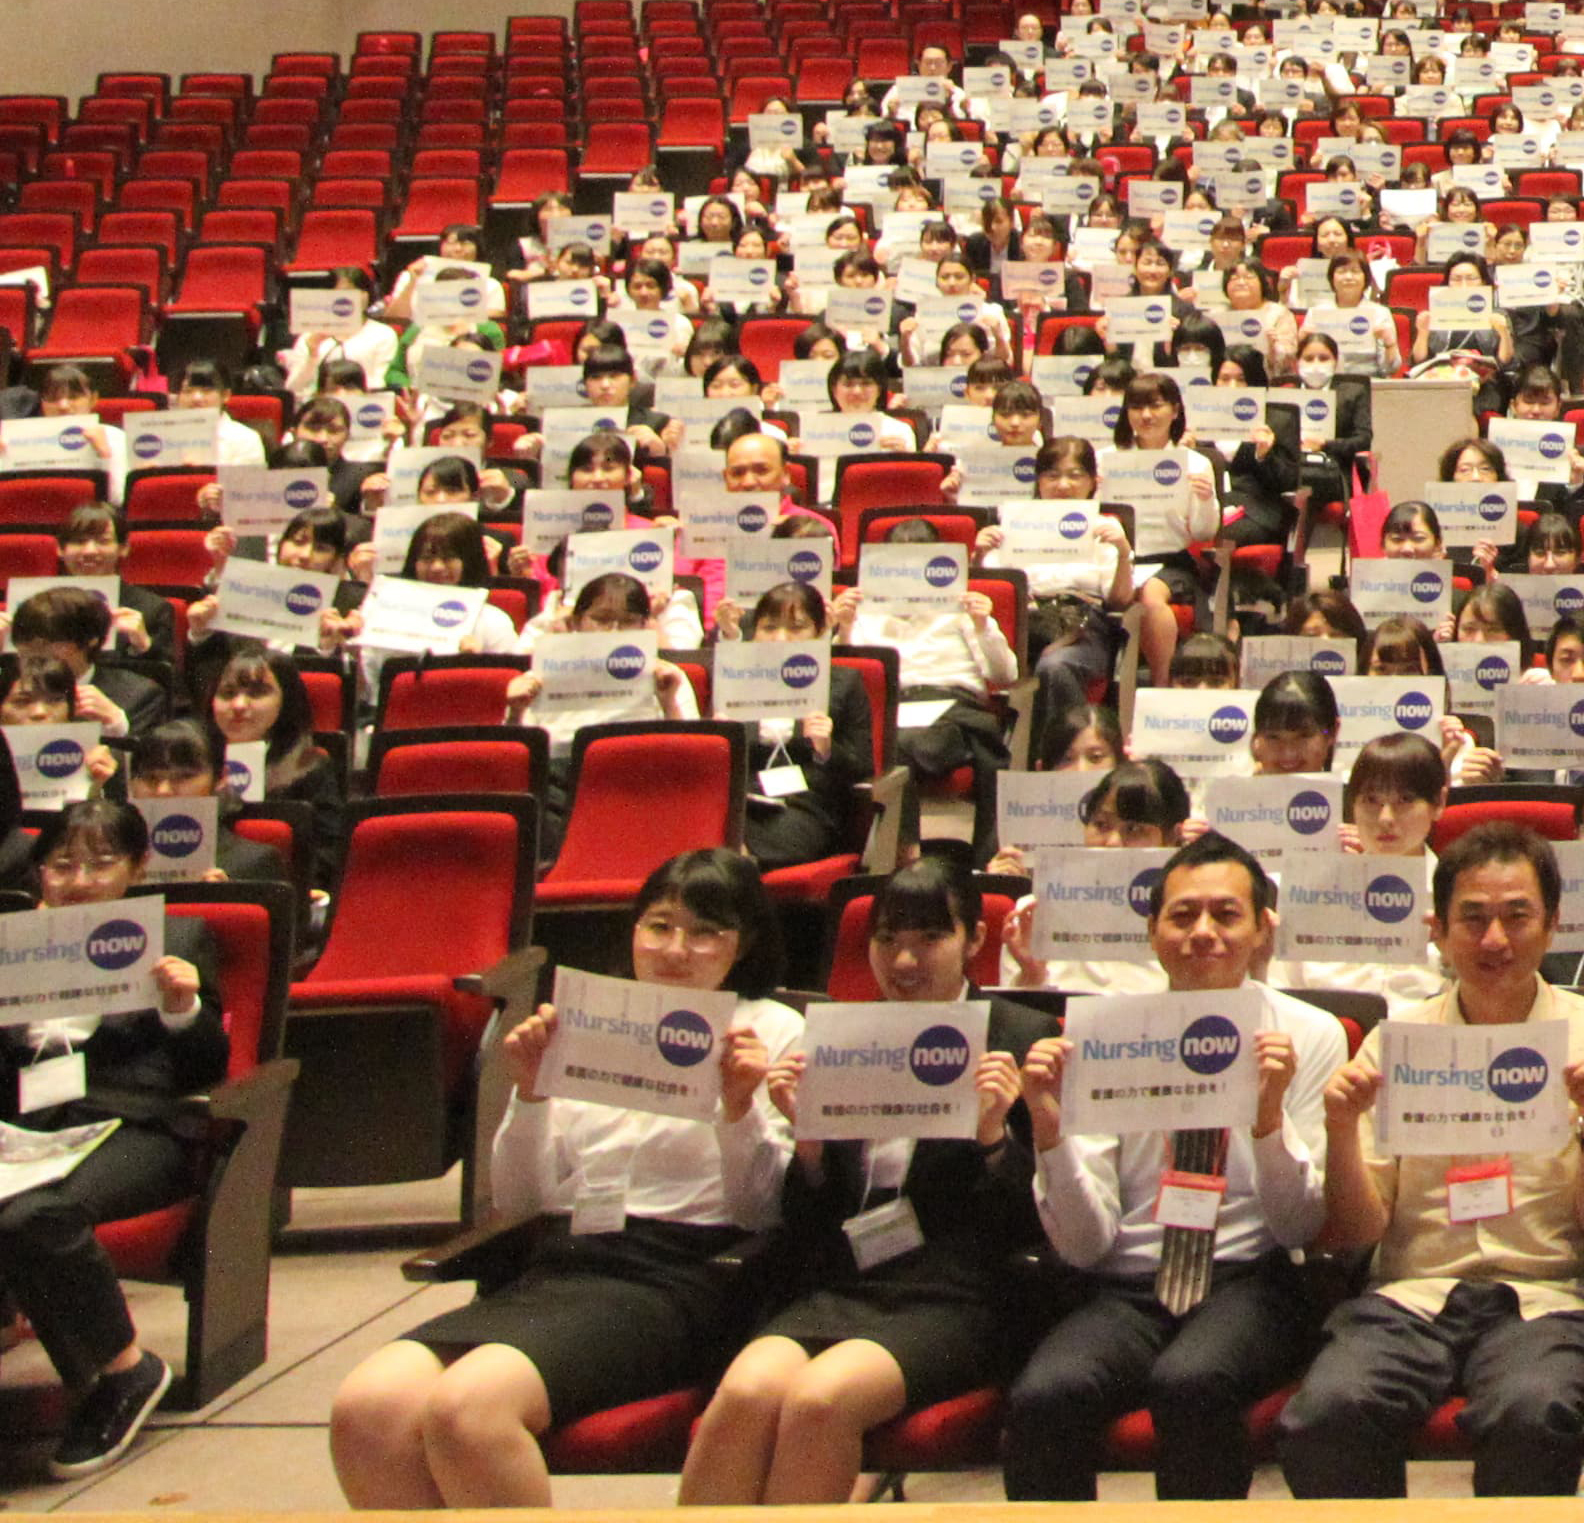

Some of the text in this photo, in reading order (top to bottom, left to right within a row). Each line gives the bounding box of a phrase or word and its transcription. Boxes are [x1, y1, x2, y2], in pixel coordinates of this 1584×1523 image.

[1234, 403, 1257, 416] now
[1540, 440, 1564, 452] now
[285, 488, 316, 501] now
[1434, 501, 1506, 515] Nursing now
[534, 511, 613, 526] Nursing now
[738, 513, 767, 525] now
[1060, 520, 1086, 533] now
[630, 551, 662, 565] now
[733, 559, 822, 575] Nursing now
[869, 565, 957, 579] Nursing now
[227, 580, 323, 608] Nursing now
[1360, 580, 1442, 595] Nursing now
[1556, 597, 1584, 609] now
[434, 606, 468, 621] now
[543, 654, 645, 675] Nursing now
[1252, 656, 1345, 675] Nursing now
[722, 665, 819, 681] Nursing now
[1477, 665, 1509, 681] now
[1395, 704, 1431, 718] now
[1144, 716, 1246, 735] Nursing now
[1505, 710, 1567, 729] Nursing
[38, 749, 83, 766] now
[1007, 801, 1074, 819] Nursing
[1216, 806, 1328, 823] Nursing now
[154, 829, 201, 844] now
[1047, 883, 1125, 905] Nursing
[1290, 887, 1411, 907] Nursing now
[88, 934, 146, 955] now
[566, 1007, 712, 1049] Nursing now
[1082, 1034, 1240, 1062] Nursing now
[813, 1042, 968, 1071] Nursing now
[1393, 1063, 1546, 1089] Nursing now
[1402, 1108, 1538, 1124] 看護の力で健康な社会を！
